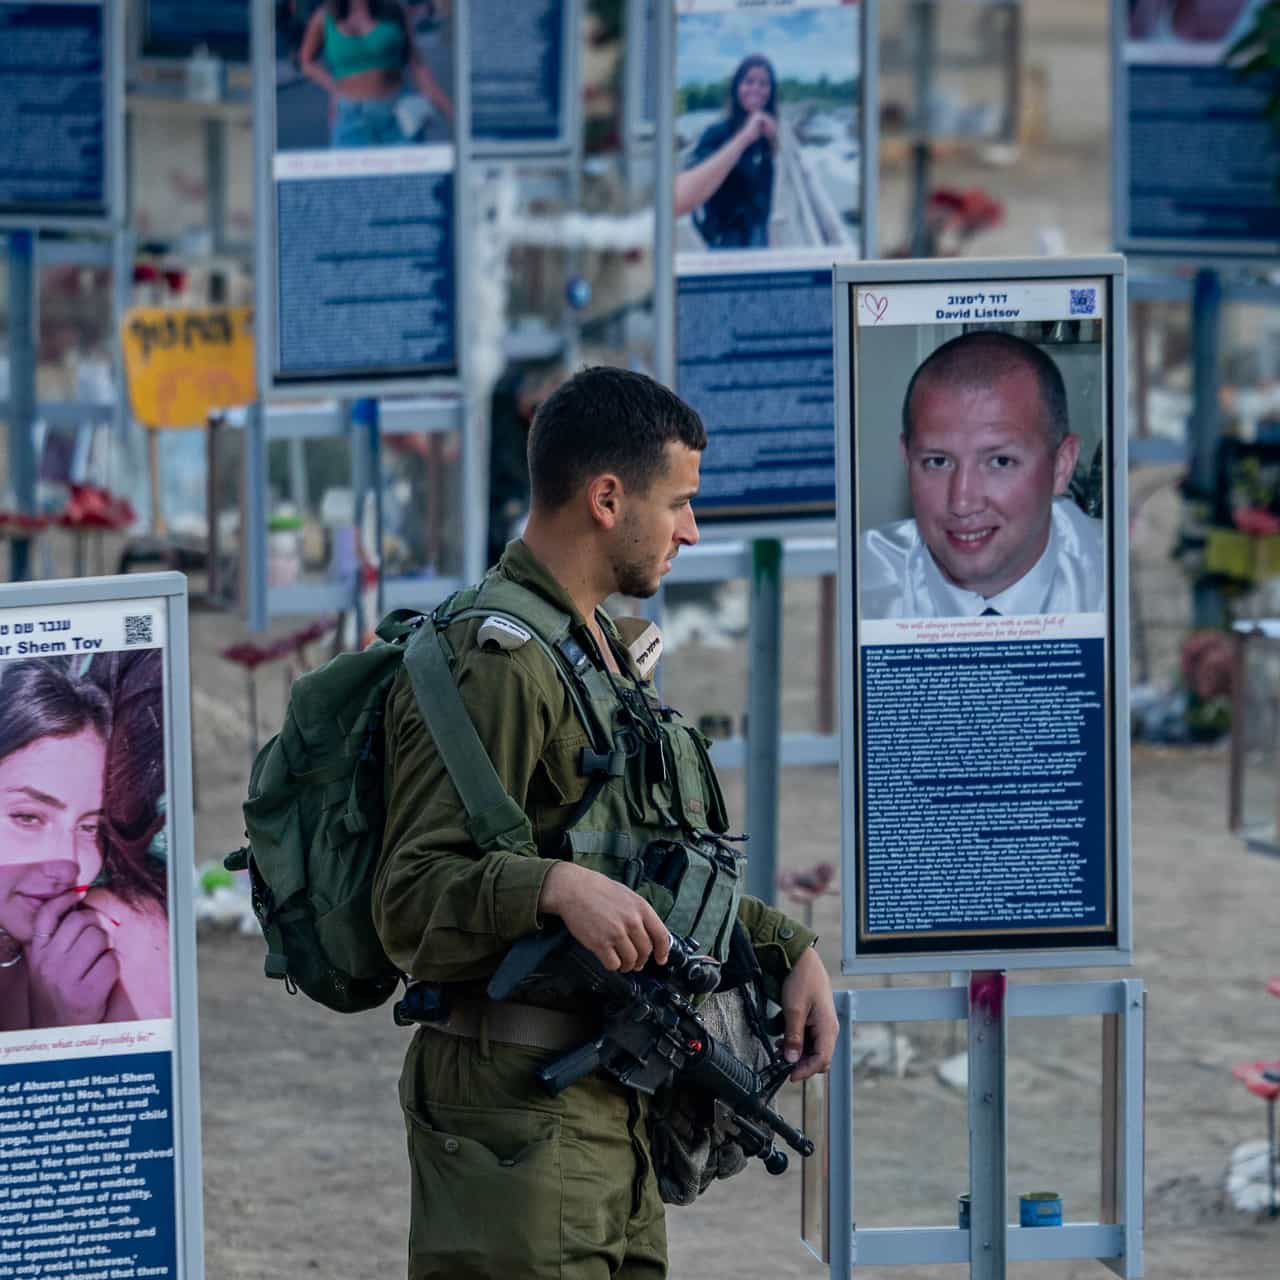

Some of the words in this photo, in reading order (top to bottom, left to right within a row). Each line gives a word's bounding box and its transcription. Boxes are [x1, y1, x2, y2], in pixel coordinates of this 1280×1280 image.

[948, 294, 985, 305] ליסצוב
[989, 294, 1007, 304] דוד
[936, 309, 971, 319] David
[975, 308, 1020, 318] Listsov
[14, 623, 34, 634] שם
[40, 620, 71, 632] ענבר
[18, 639, 66, 654] Shem
[72, 636, 102, 650] Tov
